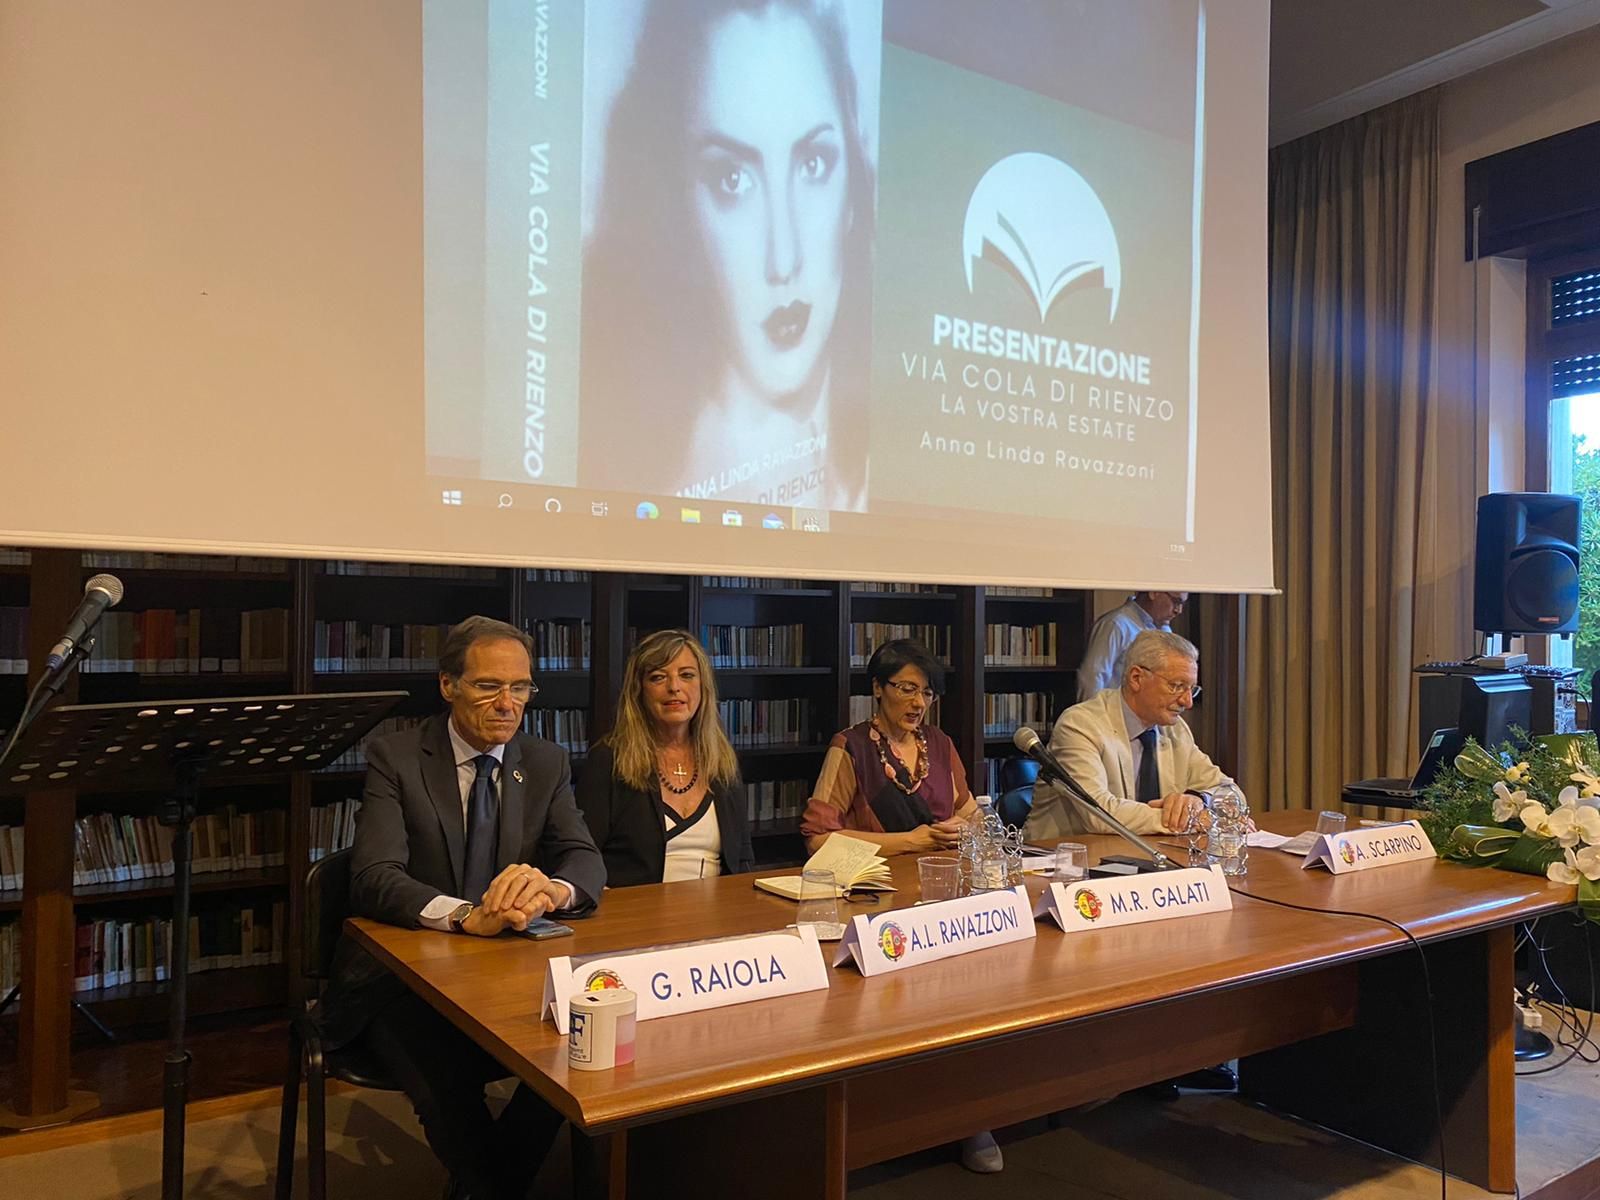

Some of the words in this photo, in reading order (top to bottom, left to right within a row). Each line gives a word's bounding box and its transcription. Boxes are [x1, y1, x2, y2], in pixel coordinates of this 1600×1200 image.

[535, 0, 549, 99] VAZZONI
[529, 142, 550, 195] VIA
[527, 205, 549, 298] COLA
[526, 308, 547, 343] DI
[932, 314, 1151, 385] PRESENTAZIONE
[901, 352, 947, 383] VIA
[962, 364, 1036, 398] COLA
[1051, 380, 1075, 405] DI
[1088, 386, 1174, 421] RIENZO
[523, 350, 546, 478] RIENZO
[941, 394, 965, 415] LA
[977, 400, 1058, 429] VOSTRA
[1068, 415, 1136, 442] ESTATE
[720, 458, 760, 491] LINDA
[920, 431, 975, 455] Anna
[987, 440, 1045, 465] Linda
[1055, 450, 1155, 480] Ravazzoni
[777, 466, 827, 505] RIENZO
[1356, 844, 1368, 861] A.
[1369, 836, 1422, 859] SCARPINO
[1110, 889, 1149, 914] M.R.
[1152, 882, 1211, 907] GALATI
[911, 926, 938, 952] A.L.
[942, 905, 1020, 945] RAVAZZONI
[651, 972, 682, 1000] G.
[690, 954, 787, 995] RAIOLA
